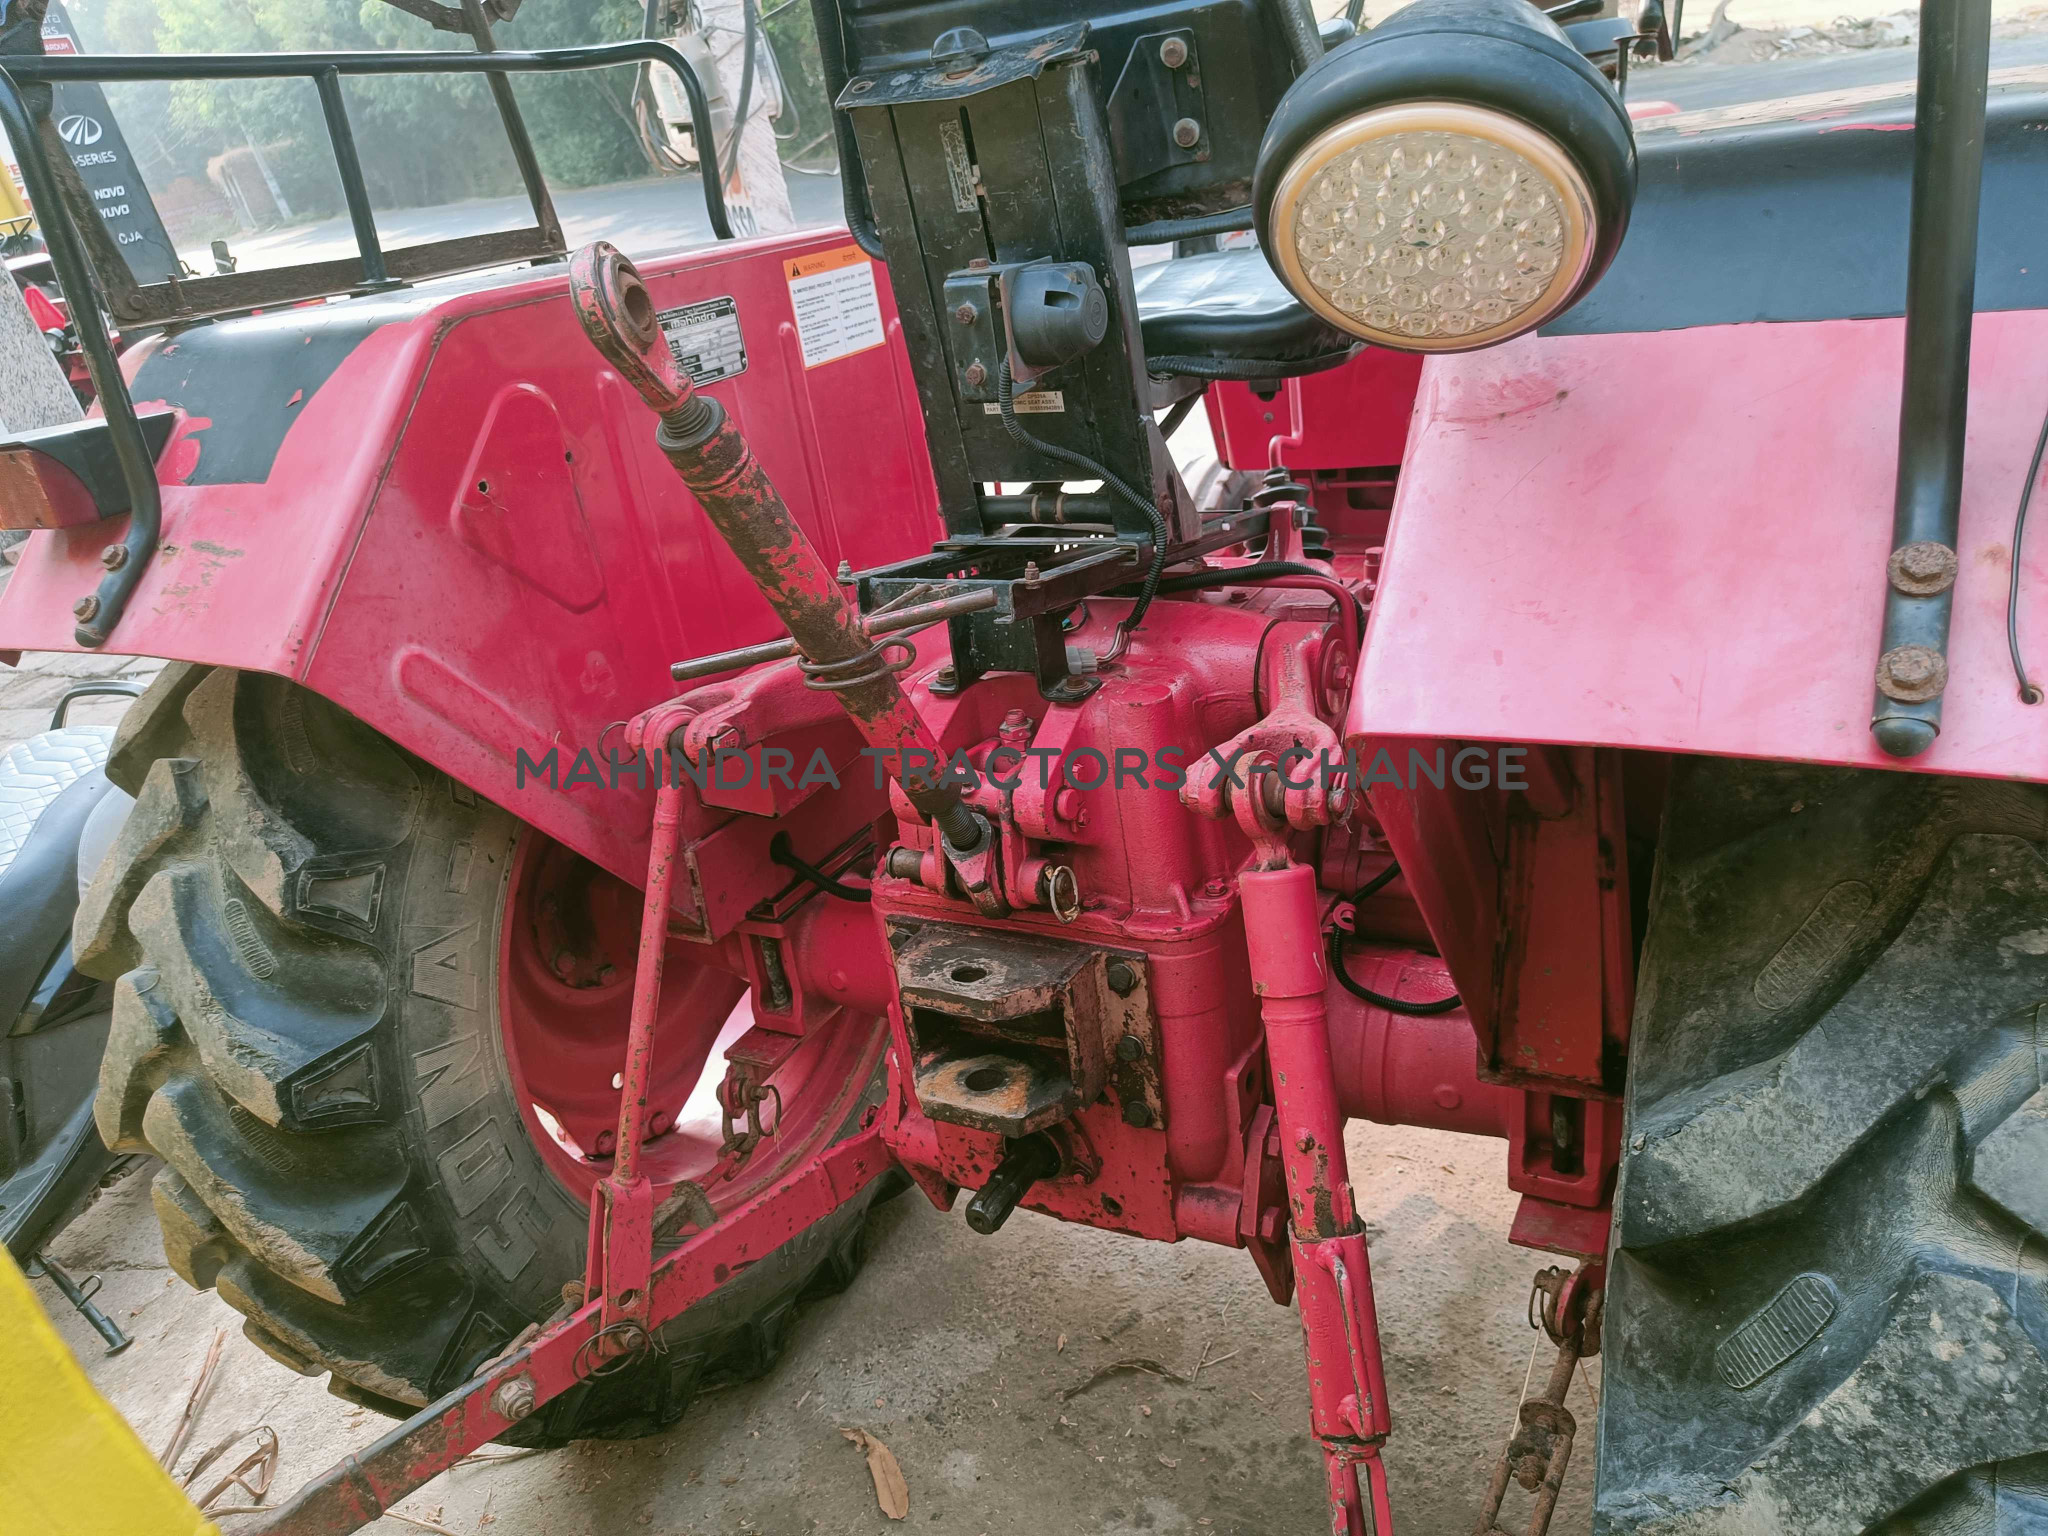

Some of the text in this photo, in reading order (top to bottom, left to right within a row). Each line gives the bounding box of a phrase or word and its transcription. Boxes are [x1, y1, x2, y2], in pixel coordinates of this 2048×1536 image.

[71, 150, 117, 168] -SERIES
[94, 185, 126, 200] NOVO
[100, 204, 130, 219] YUVO
[670, 311, 717, 330] mahindra
